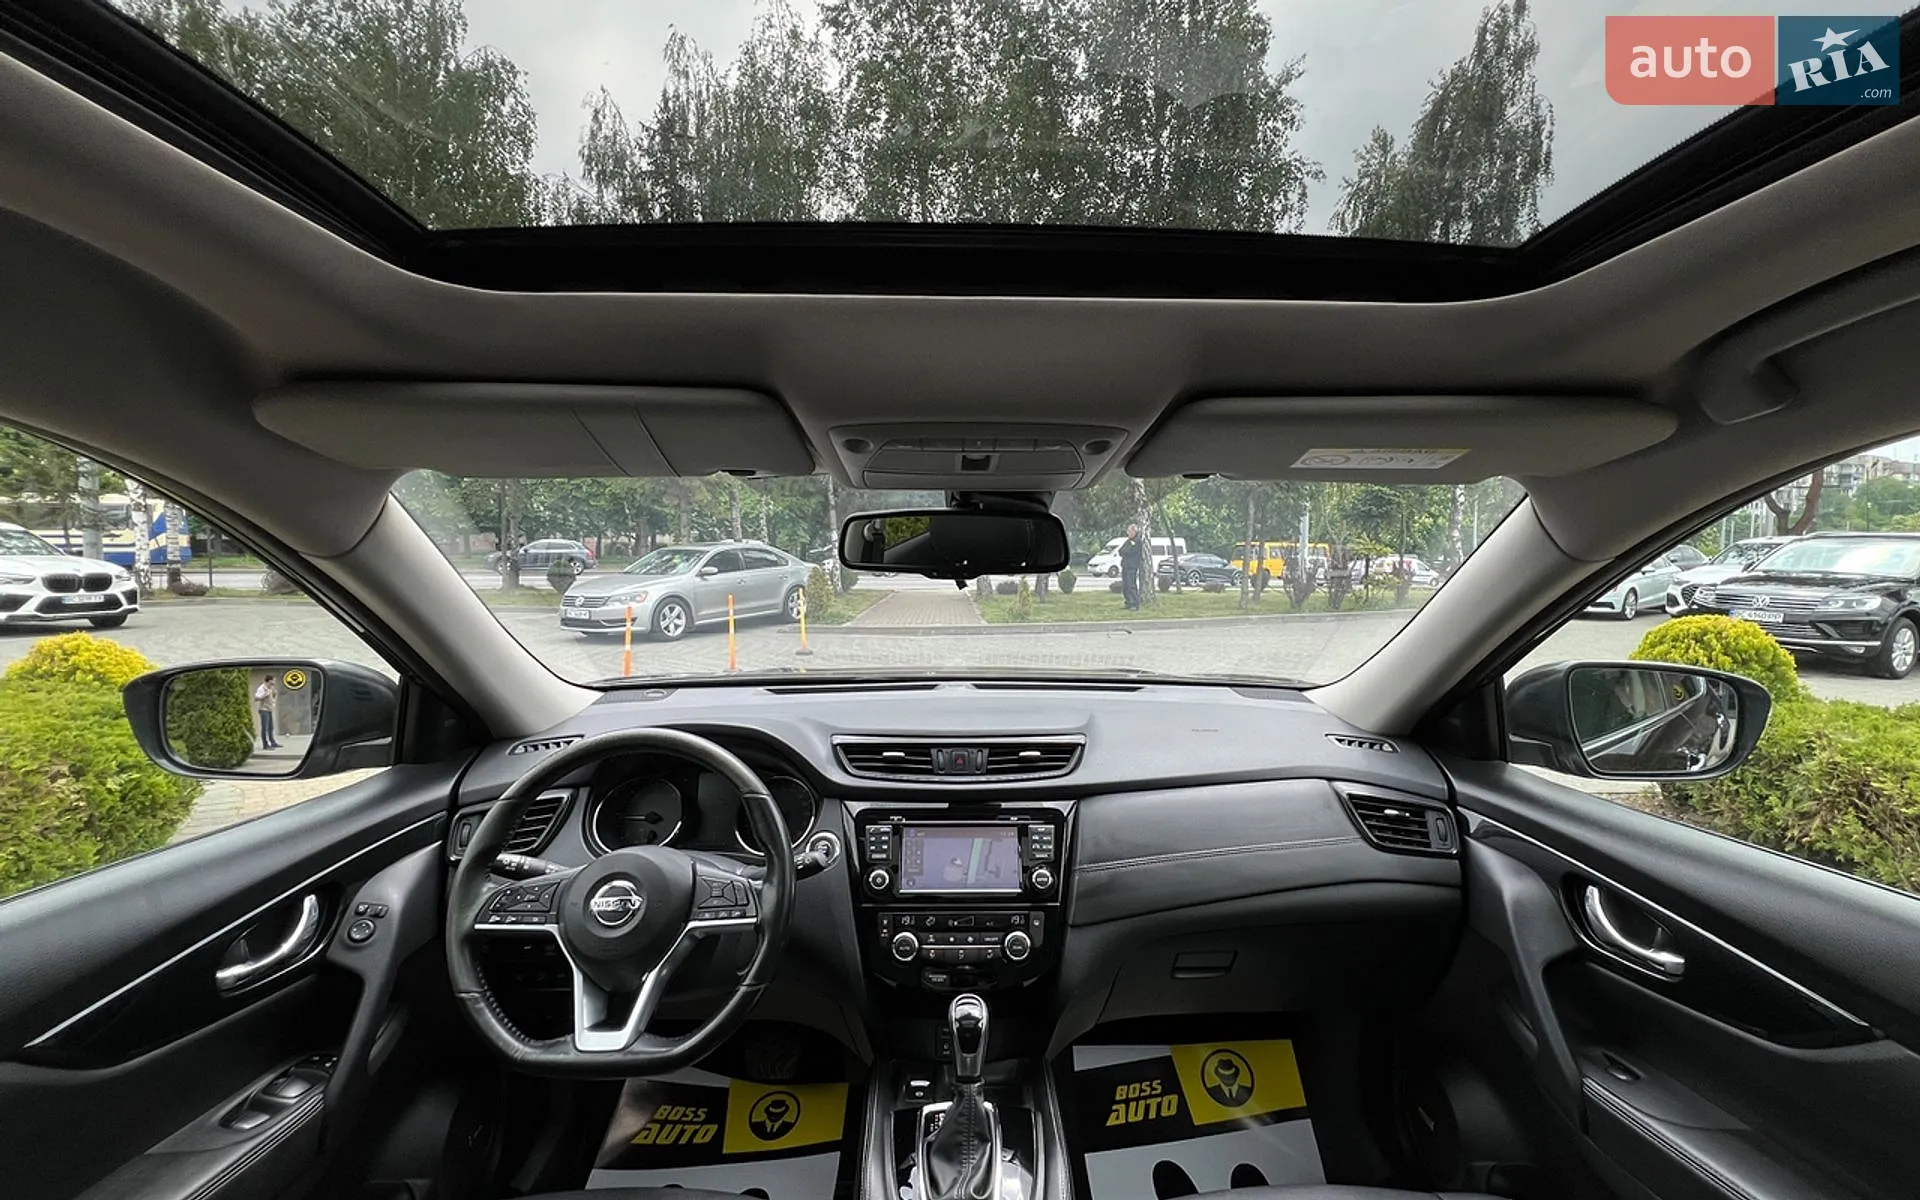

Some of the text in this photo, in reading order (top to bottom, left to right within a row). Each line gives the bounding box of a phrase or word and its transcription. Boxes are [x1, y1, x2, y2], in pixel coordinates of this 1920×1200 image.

[1115, 1079, 1162, 1100] BOSS
[654, 1105, 708, 1121] BOSS
[1106, 1094, 1178, 1126] AUTO
[631, 1123, 718, 1145] AUTO
